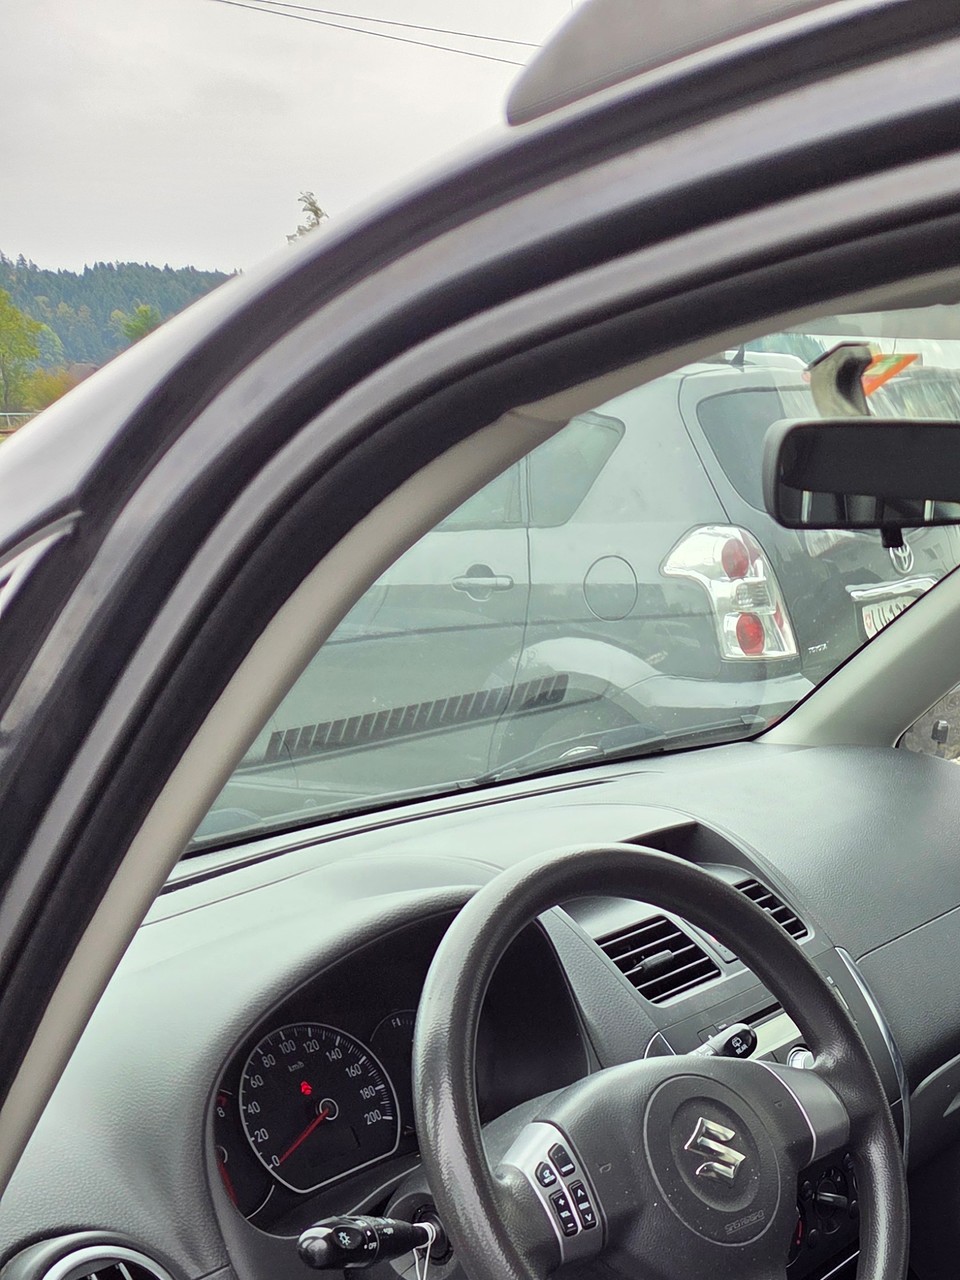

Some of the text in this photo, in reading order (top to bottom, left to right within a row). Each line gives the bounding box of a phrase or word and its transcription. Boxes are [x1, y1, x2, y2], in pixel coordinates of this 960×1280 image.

[279, 1040, 296, 1054] 100
[303, 1039, 320, 1053] 120
[262, 1054, 276, 1068] 80
[326, 1048, 342, 1062] 140
[345, 1063, 362, 1078] 160
[250, 1075, 264, 1088] 60
[360, 1085, 376, 1100] 180
[216, 1108, 225, 1118] 8
[247, 1101, 261, 1115] 40
[364, 1109, 382, 1125] 200
[254, 1128, 269, 1143] 20
[271, 1155, 281, 1167] 0
